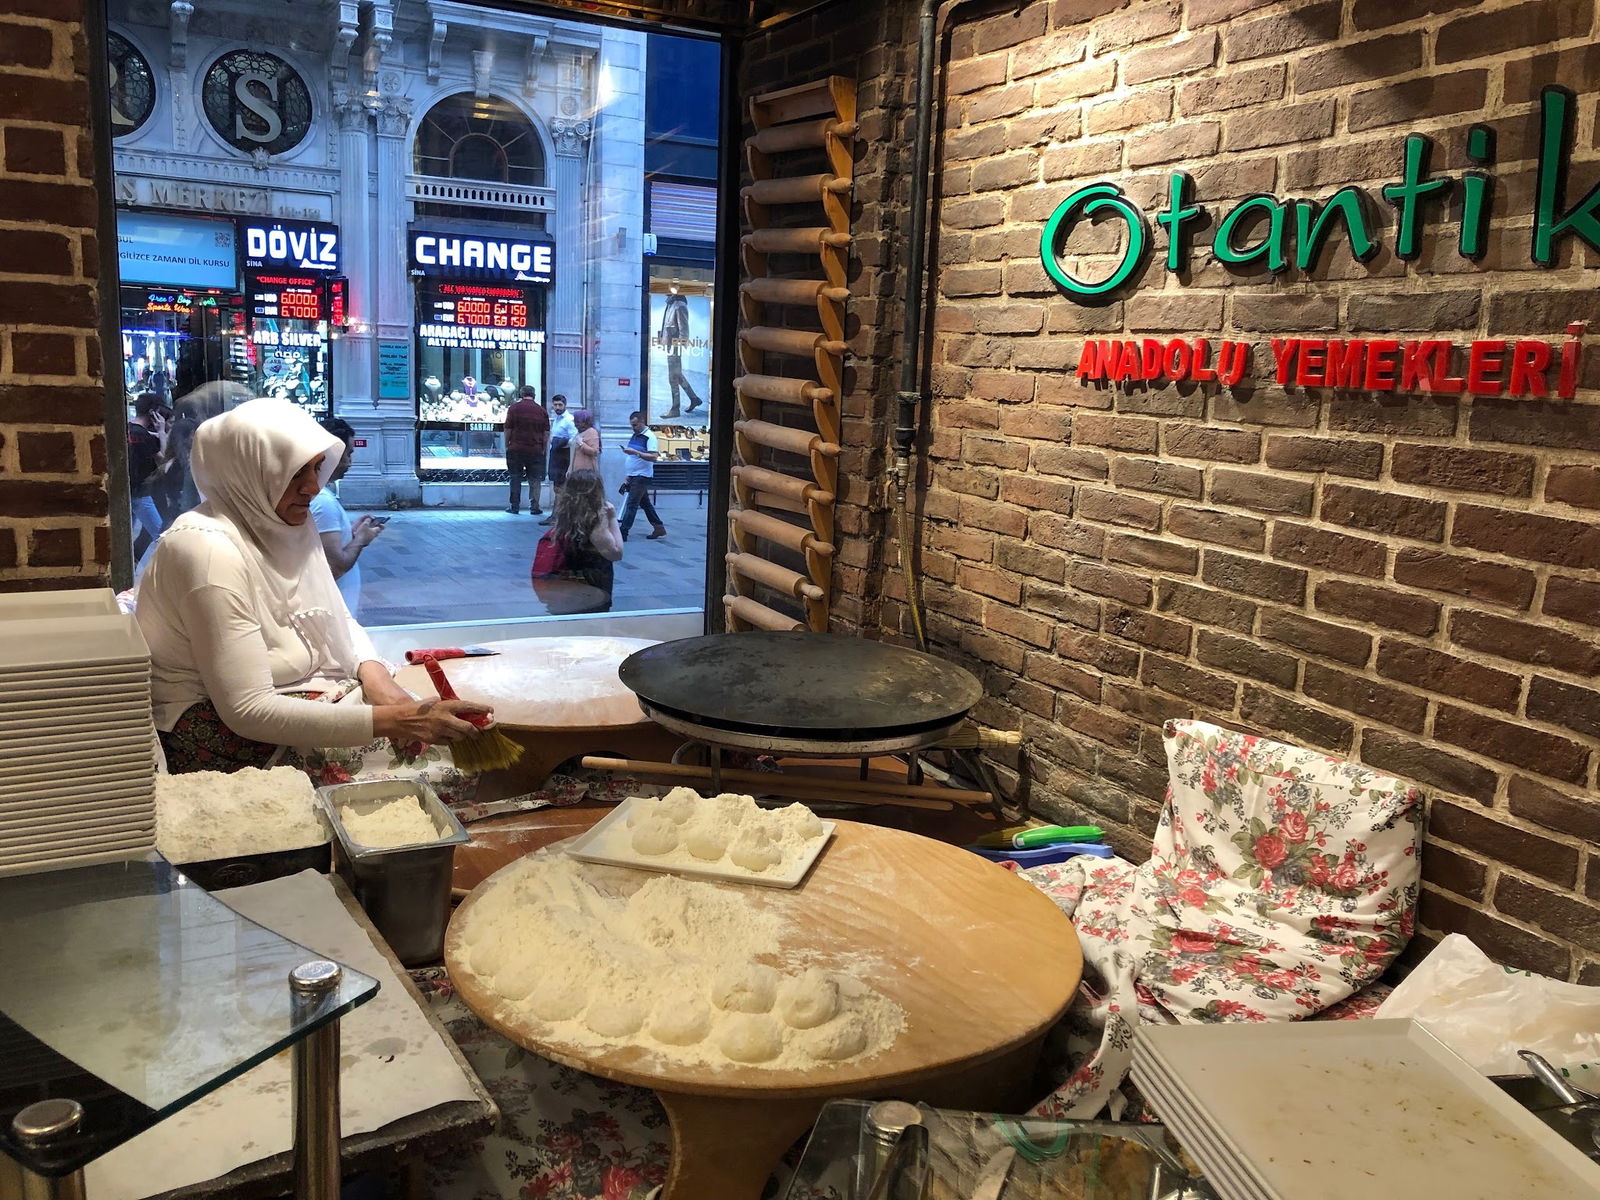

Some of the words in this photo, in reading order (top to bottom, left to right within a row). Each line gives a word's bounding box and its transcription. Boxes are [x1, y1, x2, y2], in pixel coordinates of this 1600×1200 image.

[1040, 84, 1600, 299] Otantik
[247, 225, 337, 262] DÖVİZ
[152, 254, 187, 264] ZAMANI
[188, 255, 202, 266] DİL
[203, 259, 230, 268] KURSU
[415, 236, 552, 273] CHANGE
[246, 259, 263, 268] SİNA
[411, 268, 426, 277] SİNA
[253, 330, 279, 345] ARB
[427, 338, 459, 348] ALTIN
[471, 327, 546, 344] KUYUMCULUK
[1076, 337, 1250, 387] ANADOLU
[1270, 320, 1585, 398] YEMEKLERİ
